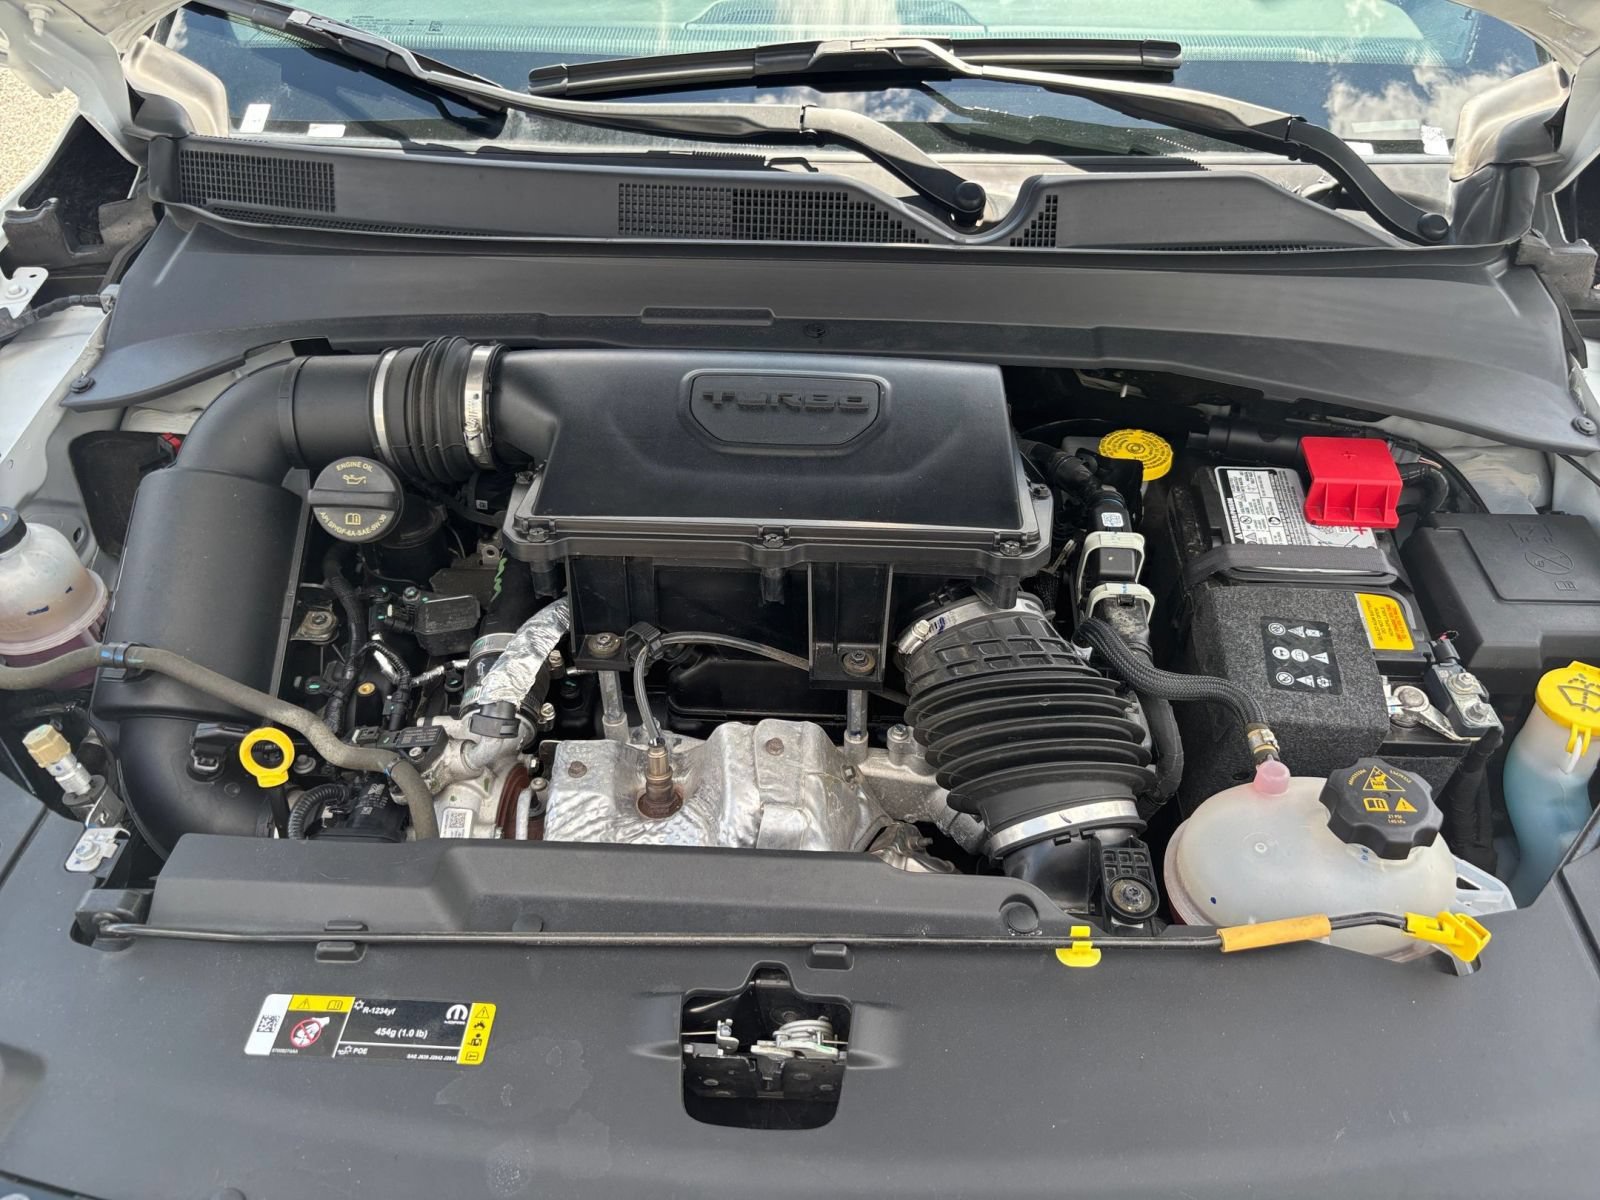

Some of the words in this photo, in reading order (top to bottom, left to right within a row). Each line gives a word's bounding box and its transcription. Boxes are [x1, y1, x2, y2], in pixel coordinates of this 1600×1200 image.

[703, 391, 869, 411] TURBO
[336, 461, 362, 472] ENGINE
[362, 463, 373, 472] OIL
[320, 511, 328, 523] API
[363, 1006, 396, 1017] R-1234yf
[374, 1028, 397, 1038] 454g
[398, 1028, 415, 1038] (1.0
[415, 1029, 428, 1039] lb)
[352, 1047, 369, 1055] POE
